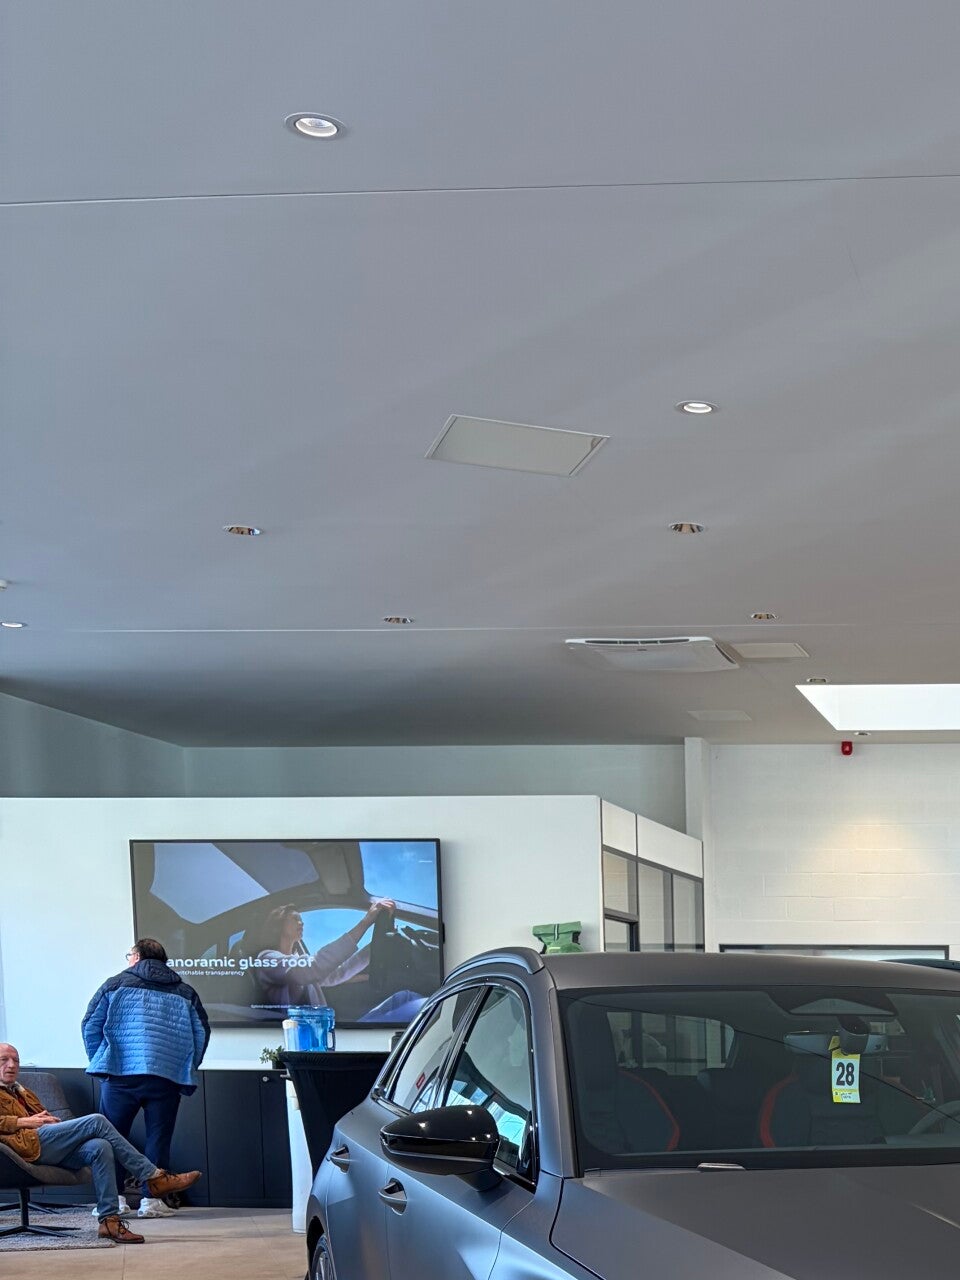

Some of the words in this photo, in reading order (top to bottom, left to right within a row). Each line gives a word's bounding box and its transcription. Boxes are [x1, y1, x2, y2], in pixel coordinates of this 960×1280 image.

[166, 956, 235, 967] anoramic
[239, 956, 278, 970] glass
[282, 955, 314, 967] roof
[836, 1062, 855, 1086] 28
